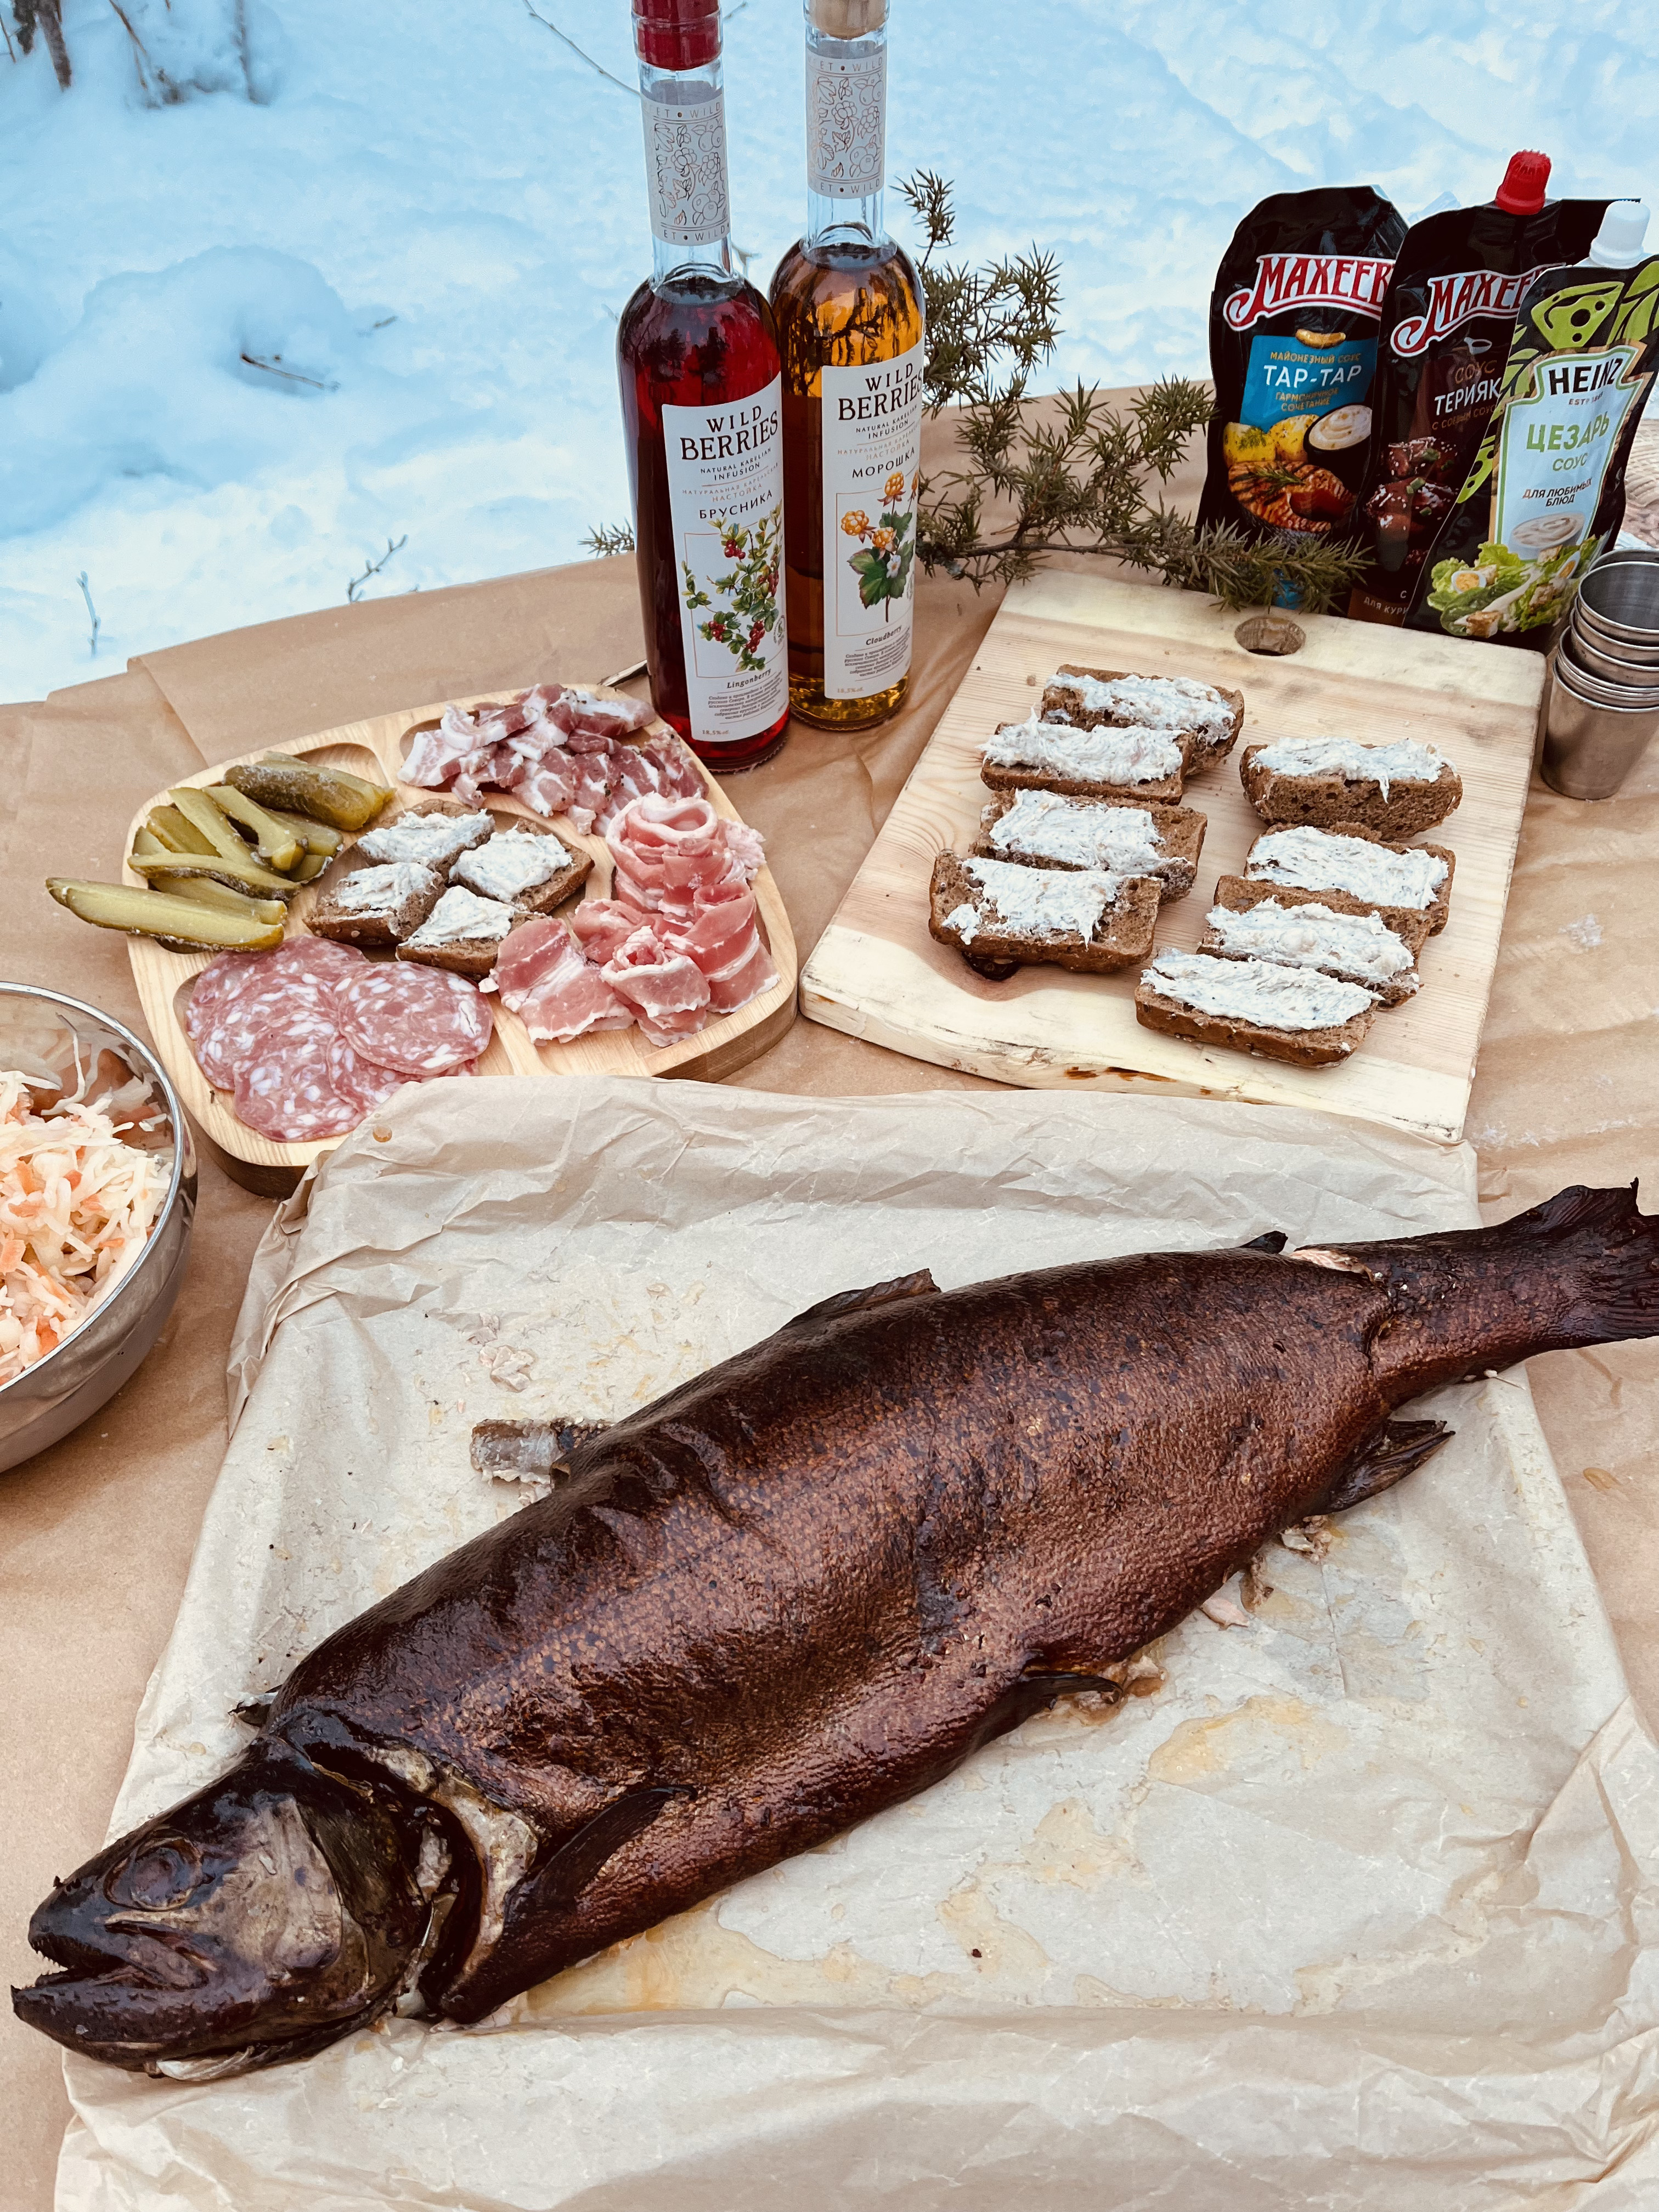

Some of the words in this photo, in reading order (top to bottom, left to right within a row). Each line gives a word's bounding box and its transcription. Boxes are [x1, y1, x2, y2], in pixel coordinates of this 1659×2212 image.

[852, 57, 883, 72] WILD
[690, 102, 720, 119] WILD
[851, 178, 880, 194] WILD
[695, 225, 725, 241] WILD
[1269, 351, 1335, 364] МАЙОНЕЗНЫЙ
[865, 362, 913, 392] WILD
[1263, 364, 1362, 388] ТАР-ТАР
[1454, 359, 1497, 385] СОУС
[1548, 358, 1624, 396] HEINZ
[838, 368, 923, 421] BERRIES
[1434, 376, 1502, 416] ТЕРИЯК
[706, 405, 761, 433] WILD
[855, 421, 889, 433] NATURAL
[892, 404, 917, 424] KARELIAN
[868, 418, 909, 439] INFUSION
[680, 410, 778, 461] BERRIES
[1526, 411, 1610, 453] ЦЕЗАРЬ
[837, 442, 892, 455] НАТУРАЛЬНАЯ
[865, 438, 910, 461] НАСТОЙКА
[700, 463, 736, 474] NATURAL
[740, 447, 771, 467] KARELIAN
[714, 461, 760, 481] INFUSION
[851, 445, 916, 479] МОРОШКА
[1552, 452, 1589, 472] СОУС
[681, 484, 740, 495] НАТУРАЛЬНАЯ
[712, 482, 763, 503] НАСТОЙКА
[1522, 488, 1545, 499] ДЛЯ
[1546, 477, 1592, 498] ЛЮБИМЫХ
[699, 489, 772, 519] БРУСНИКА
[1545, 493, 1575, 507] БЛЮД
[1363, 596, 1382, 610] ДЛЯ
[865, 625, 902, 646] Cloudberry
[726, 668, 772, 689] Lingonberry
